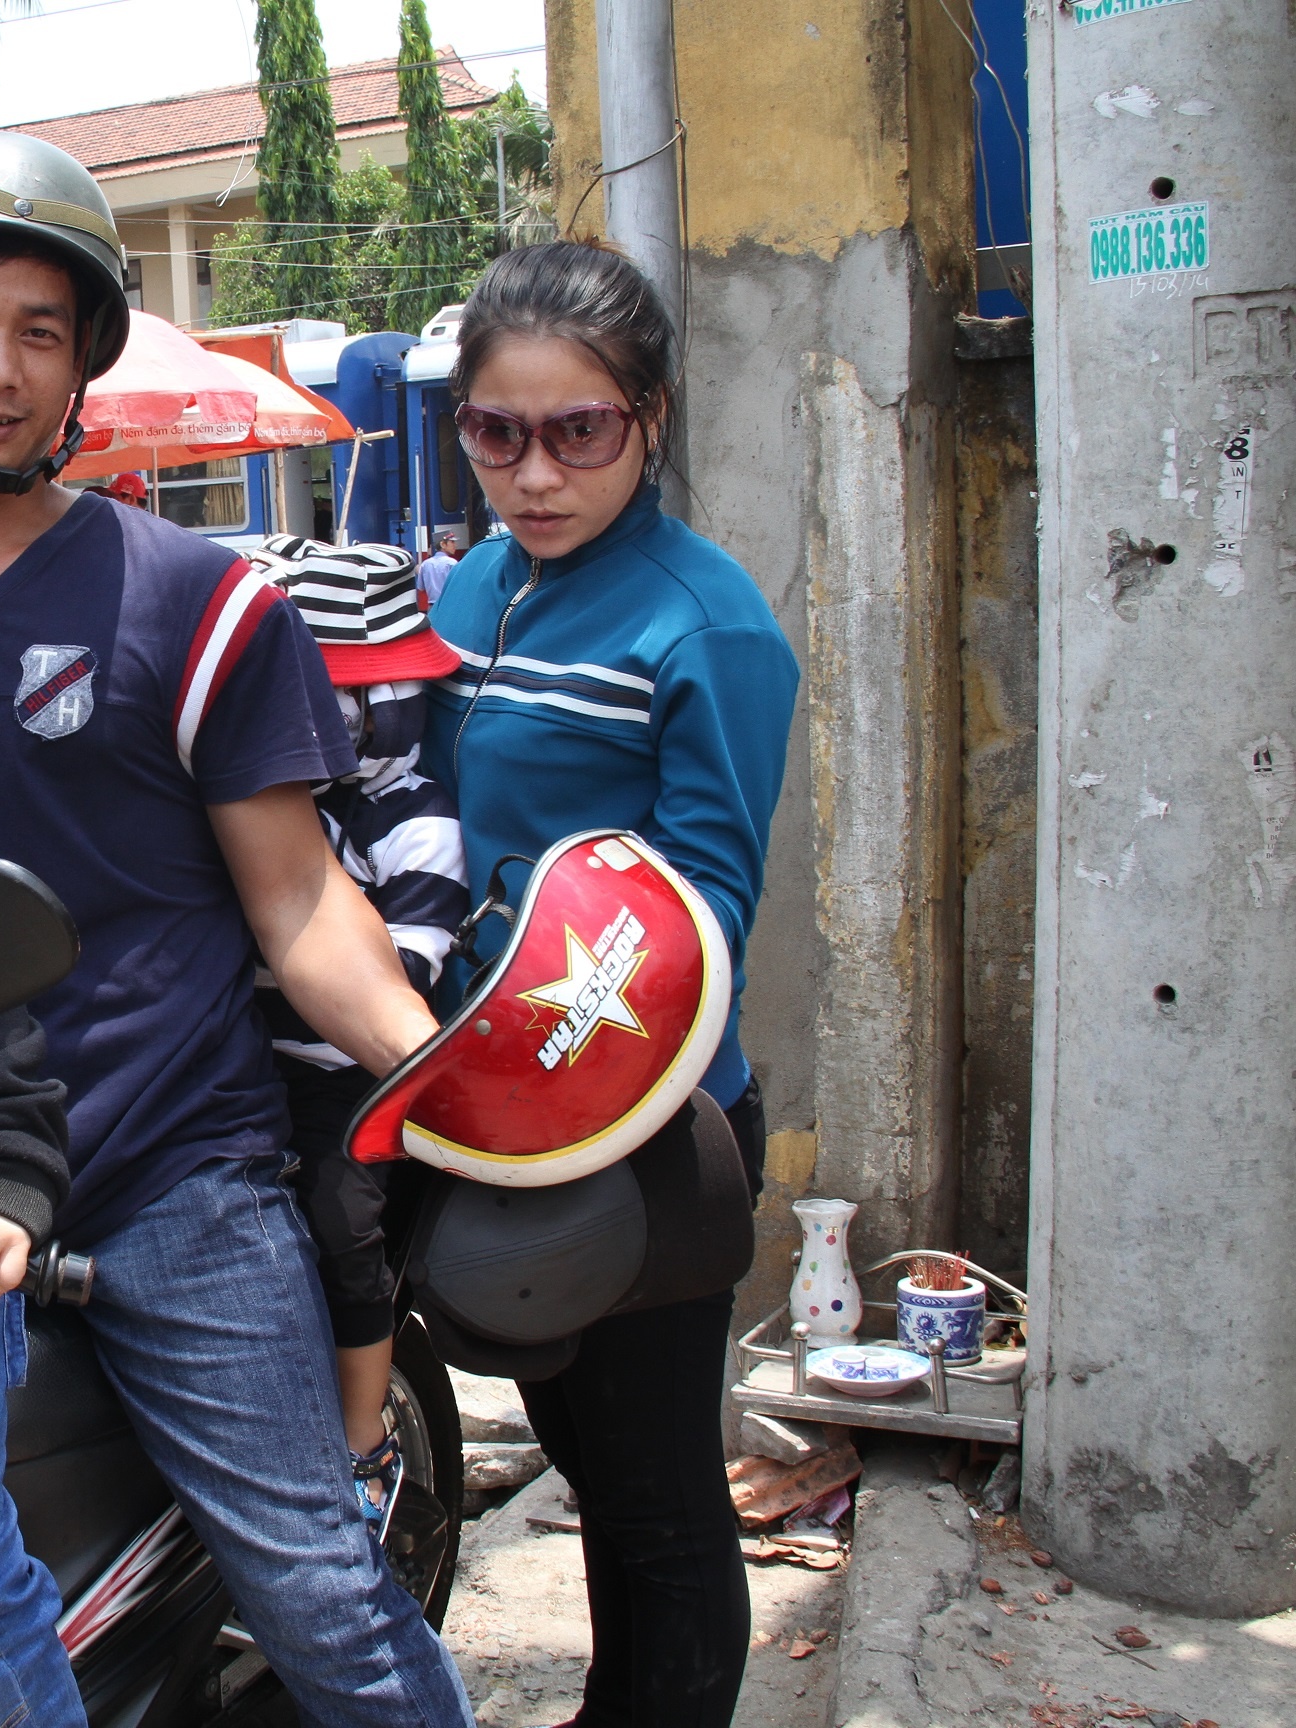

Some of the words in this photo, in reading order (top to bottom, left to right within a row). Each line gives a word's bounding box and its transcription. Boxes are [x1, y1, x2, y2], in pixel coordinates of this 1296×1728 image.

[1090, 214, 1205, 280] 0988.136.336
[24, 660, 90, 715] HILFIGER
[536, 913, 647, 1071] ROCKSTAR
